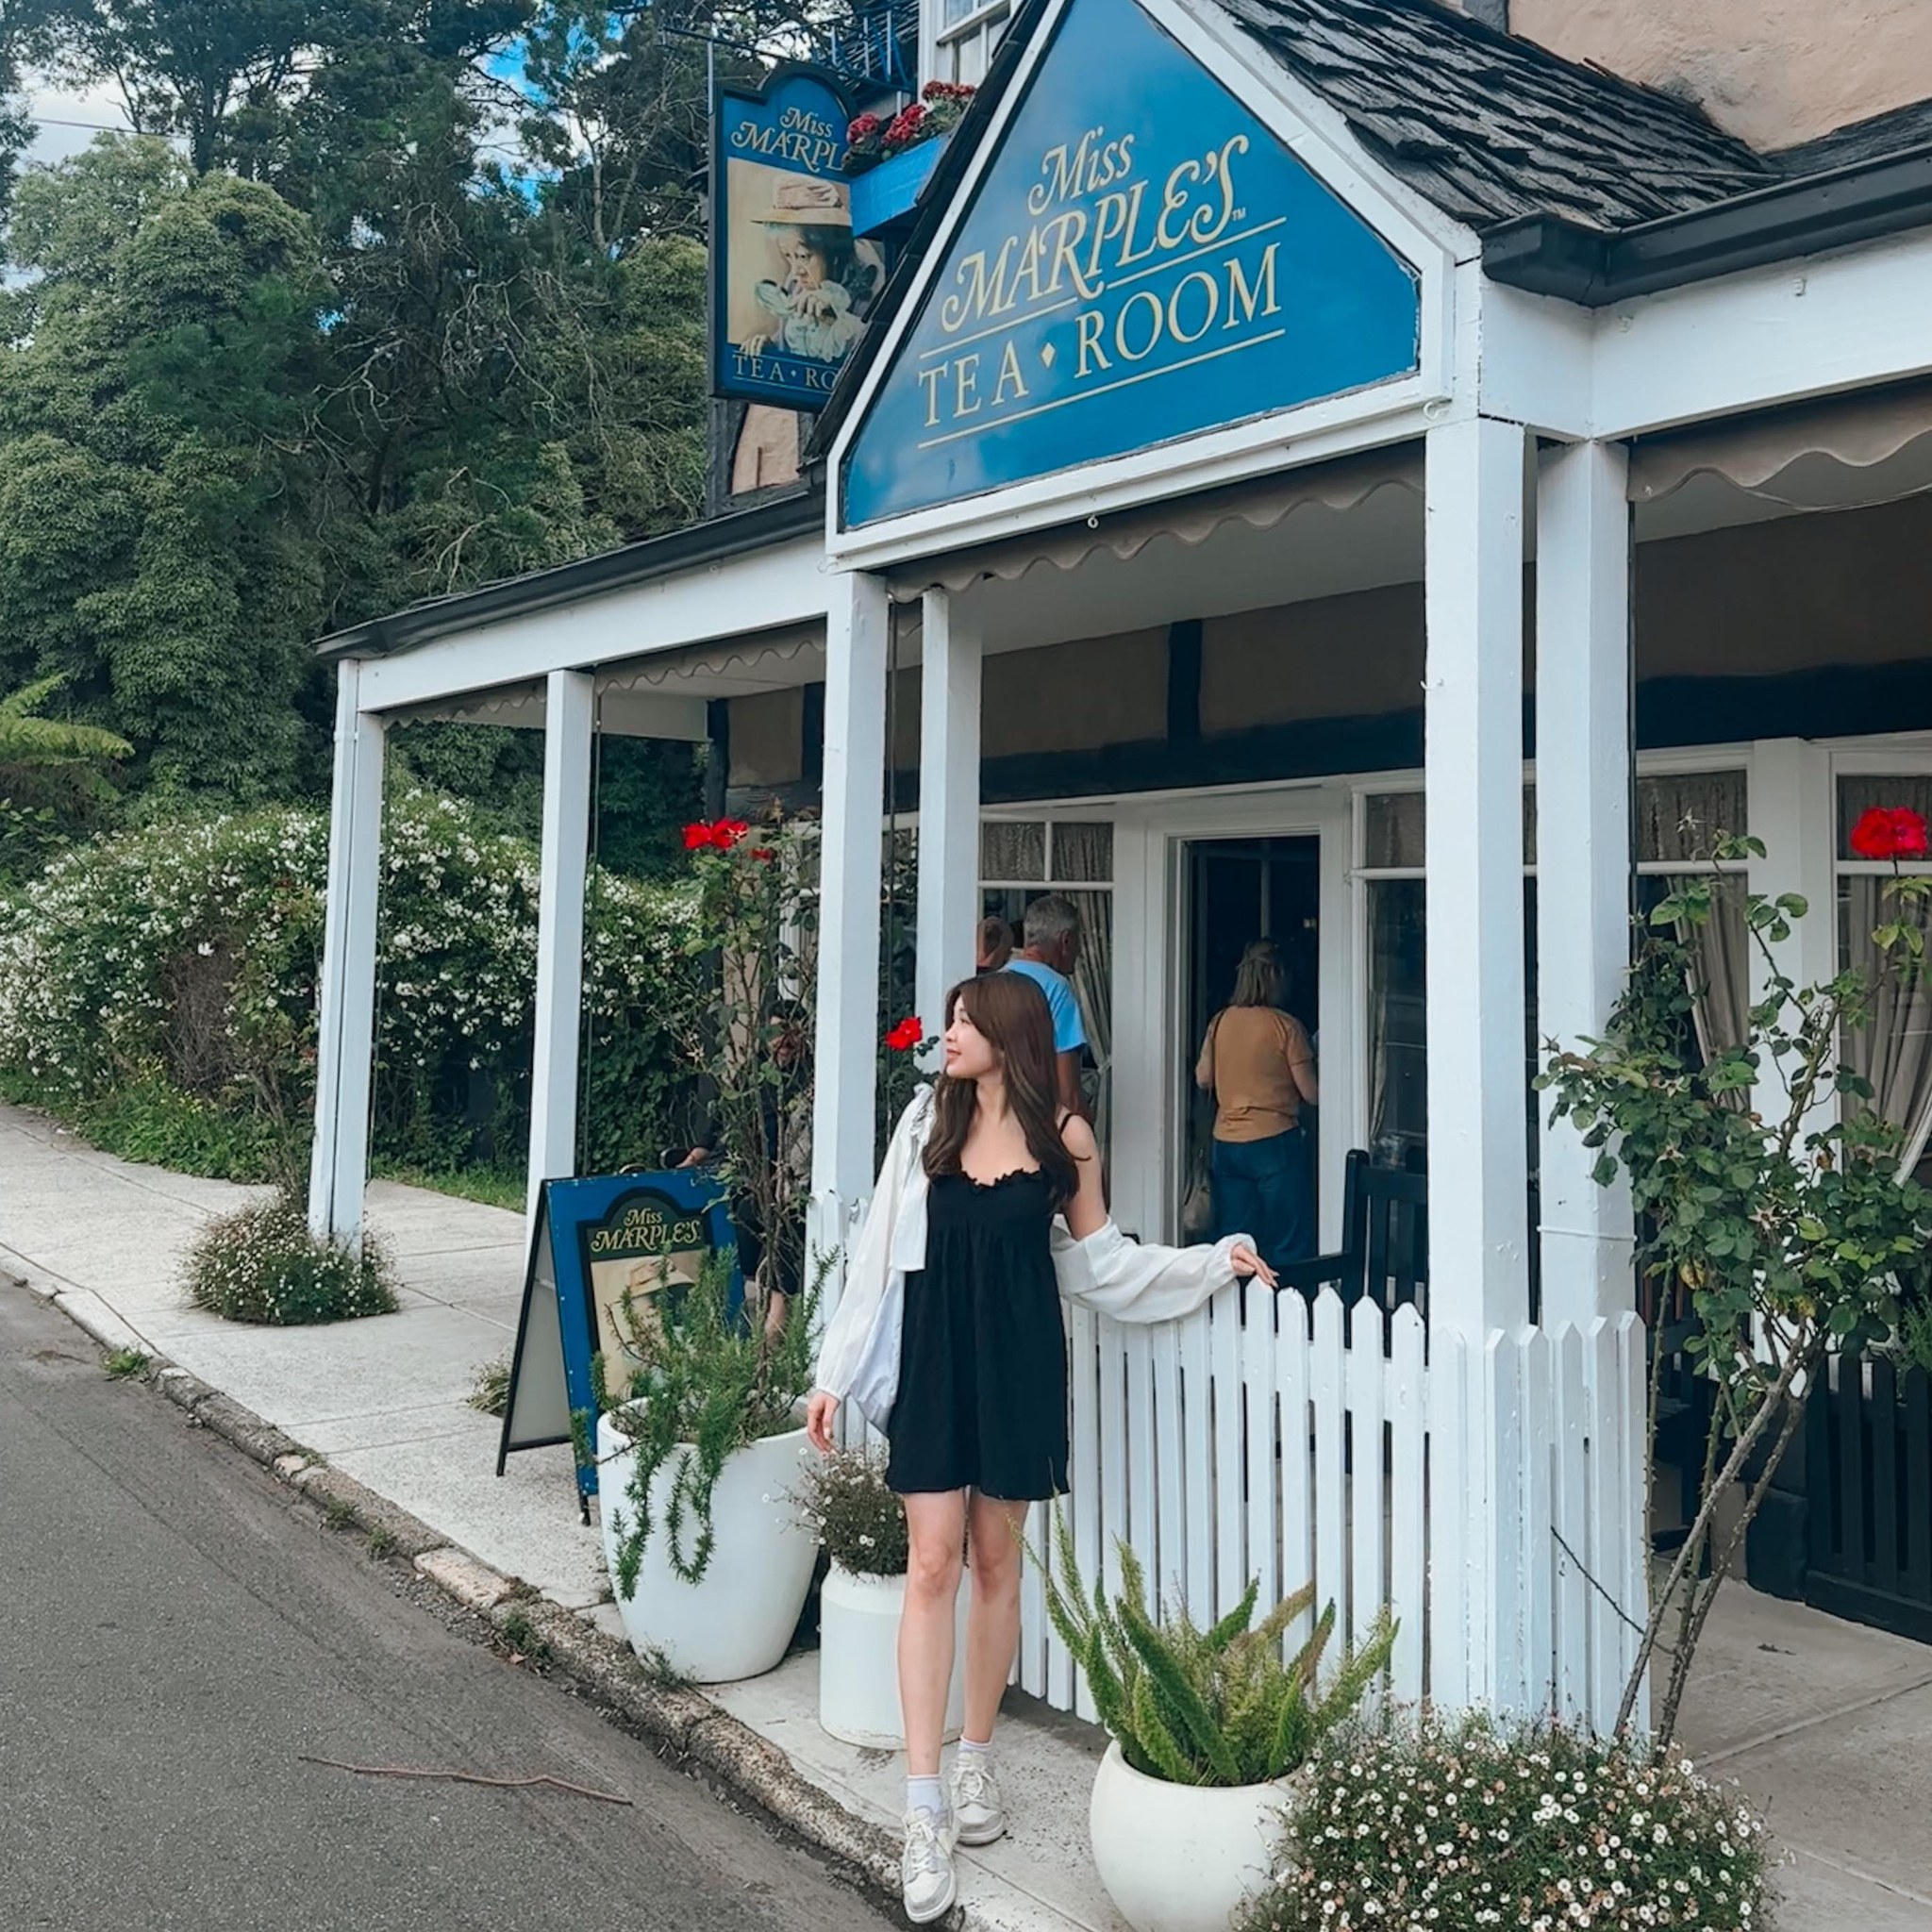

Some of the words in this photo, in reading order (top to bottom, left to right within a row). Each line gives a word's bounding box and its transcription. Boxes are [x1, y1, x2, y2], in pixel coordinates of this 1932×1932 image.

[780, 107, 833, 138] Miss
[731, 121, 844, 173] MARPL
[1027, 125, 1135, 216] Miss
[941, 134, 1249, 332] MARPLE'S
[919, 341, 1029, 427] TEA
[1074, 242, 1282, 379] ROOM
[732, 354, 785, 382] TEA
[805, 367, 837, 391] RO
[591, 1220, 701, 1252] MARPLE'S
[624, 1208, 663, 1226] Miss
